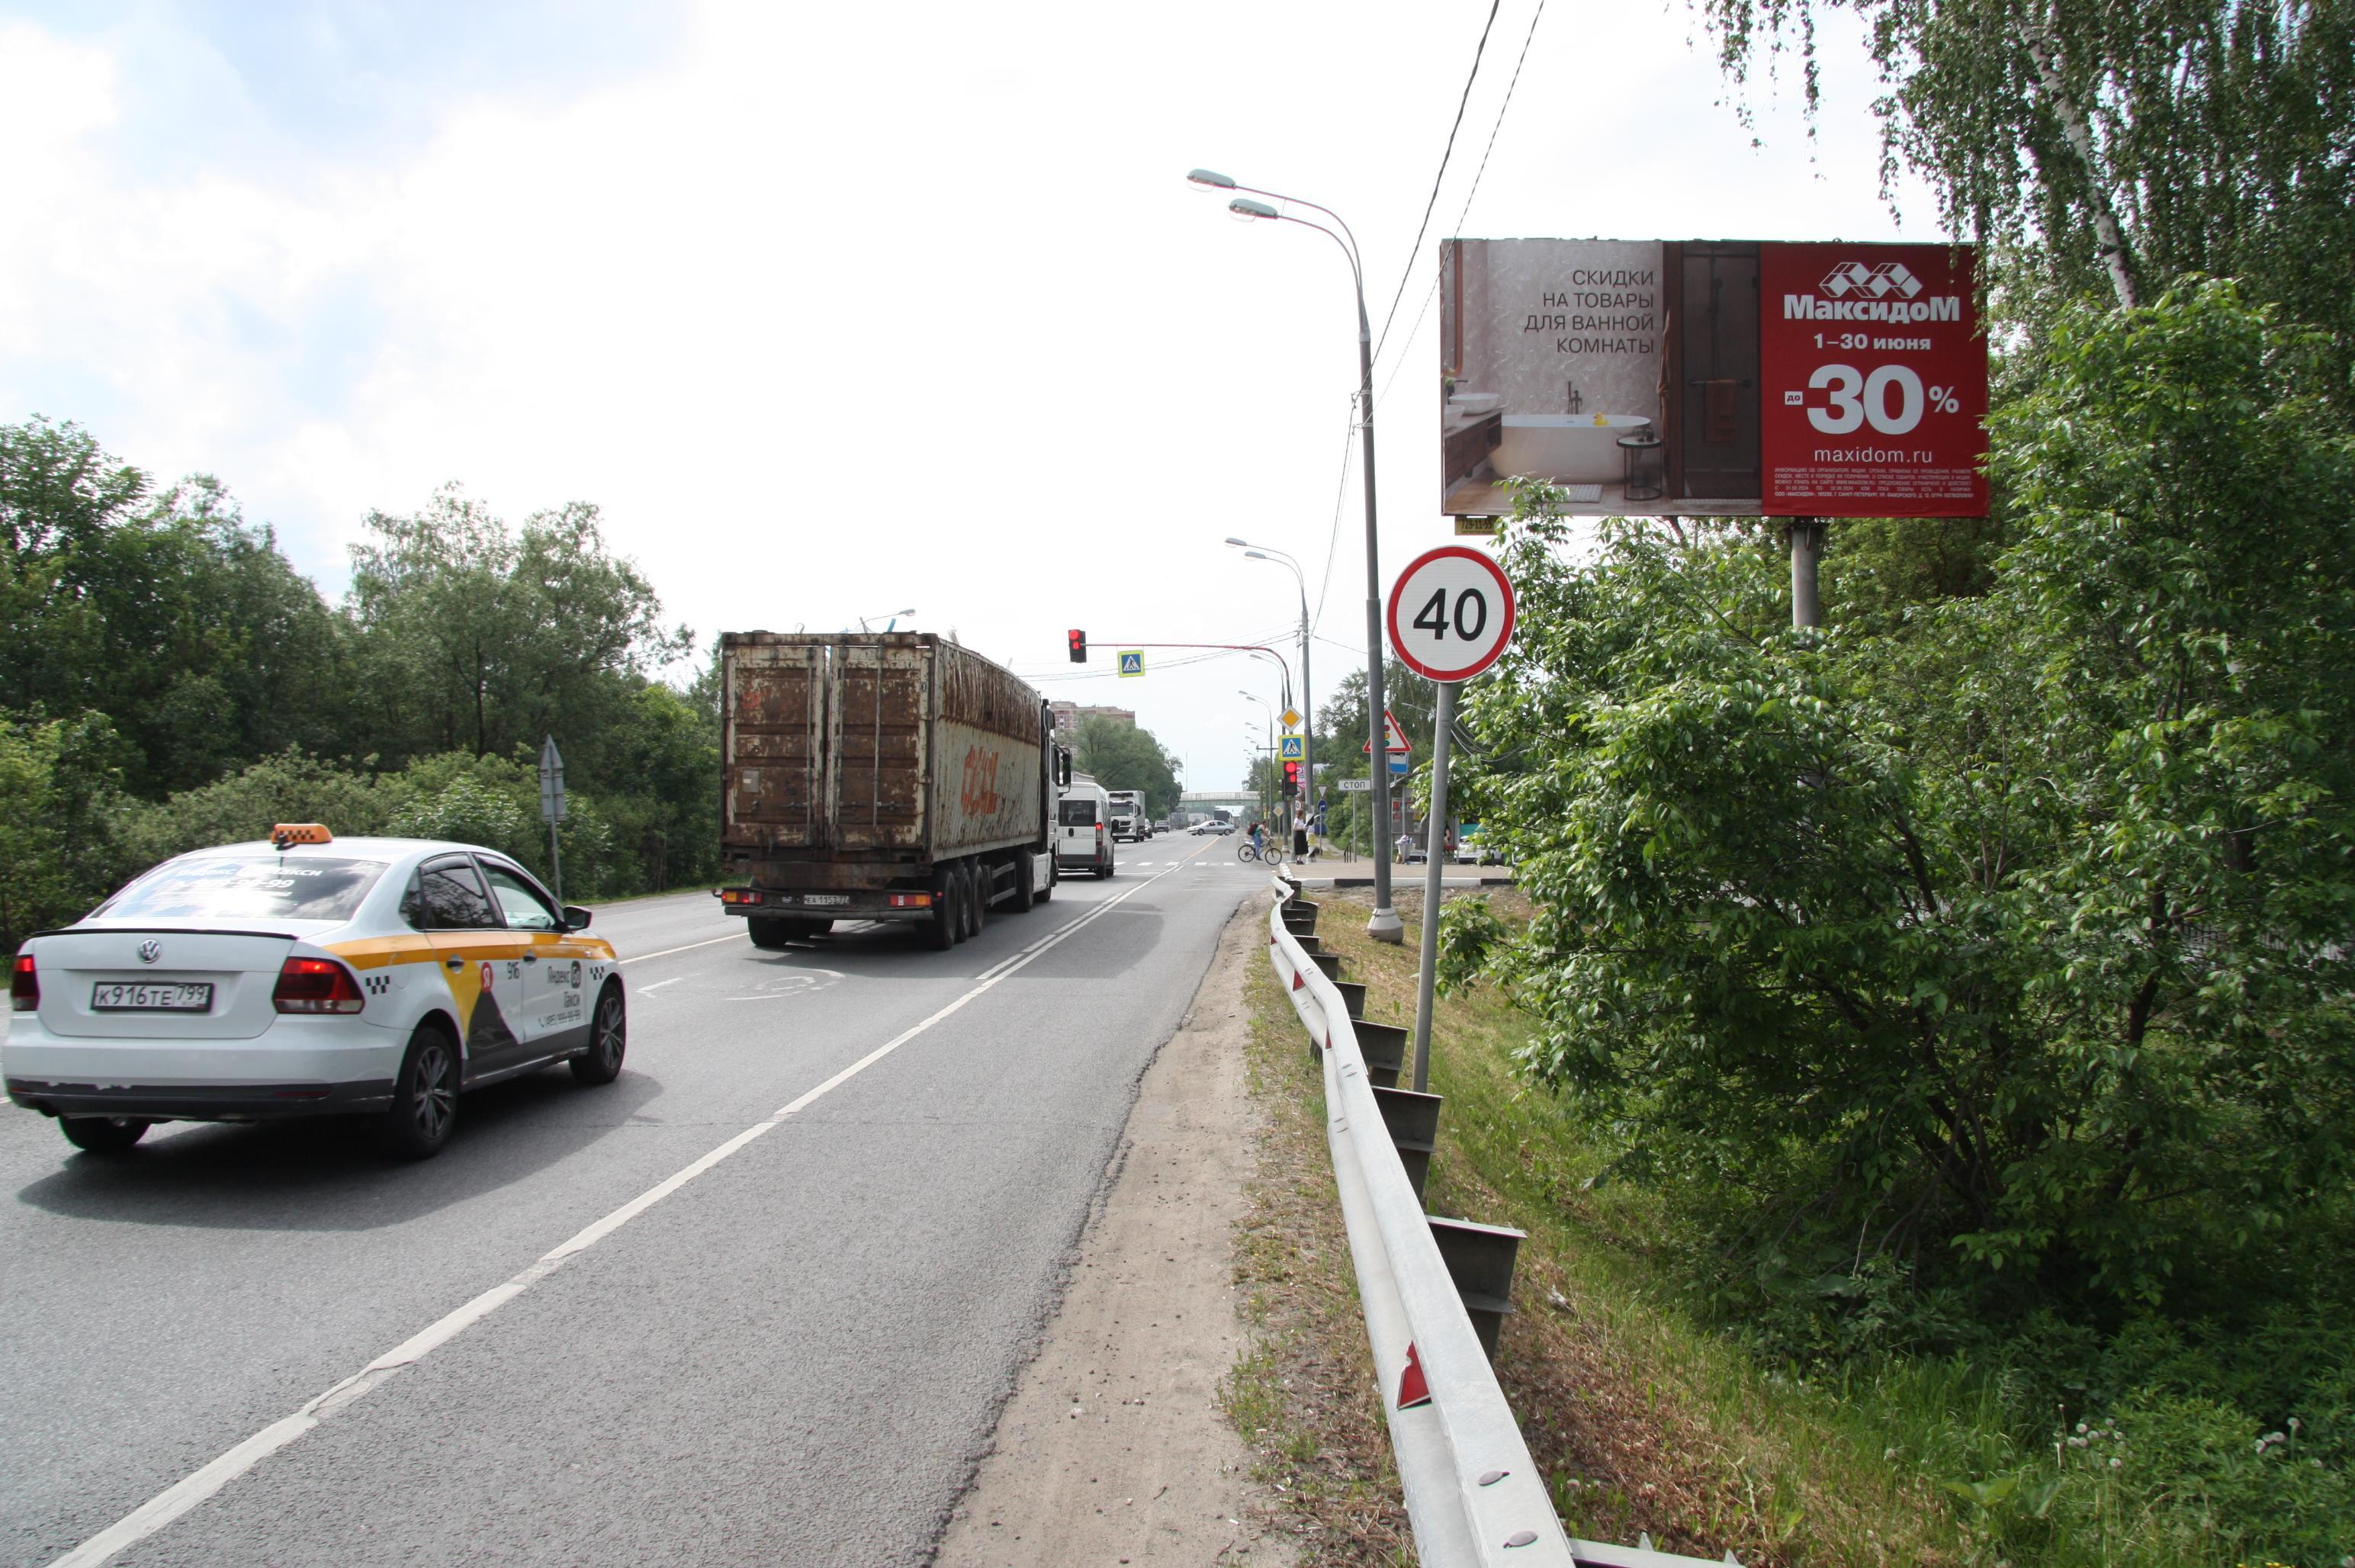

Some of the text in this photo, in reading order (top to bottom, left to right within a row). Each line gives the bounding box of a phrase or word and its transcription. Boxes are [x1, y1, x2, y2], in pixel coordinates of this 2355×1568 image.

[1572, 269, 1654, 289] СКИДКИ
[1543, 292, 1654, 309] НА ТОВАРЫ
[1783, 294, 1961, 324] МаксидоМ
[1524, 313, 1654, 333] ДЛЯ ВАННОЙ
[1557, 337, 1654, 354] КОМНАТЫ
[1873, 337, 1932, 351] июня
[1786, 394, 1801, 403] до
[1814, 447, 1933, 464] maxidom.ru
[1412, 587, 1487, 642] 40
[1343, 781, 1366, 789] СТОП
